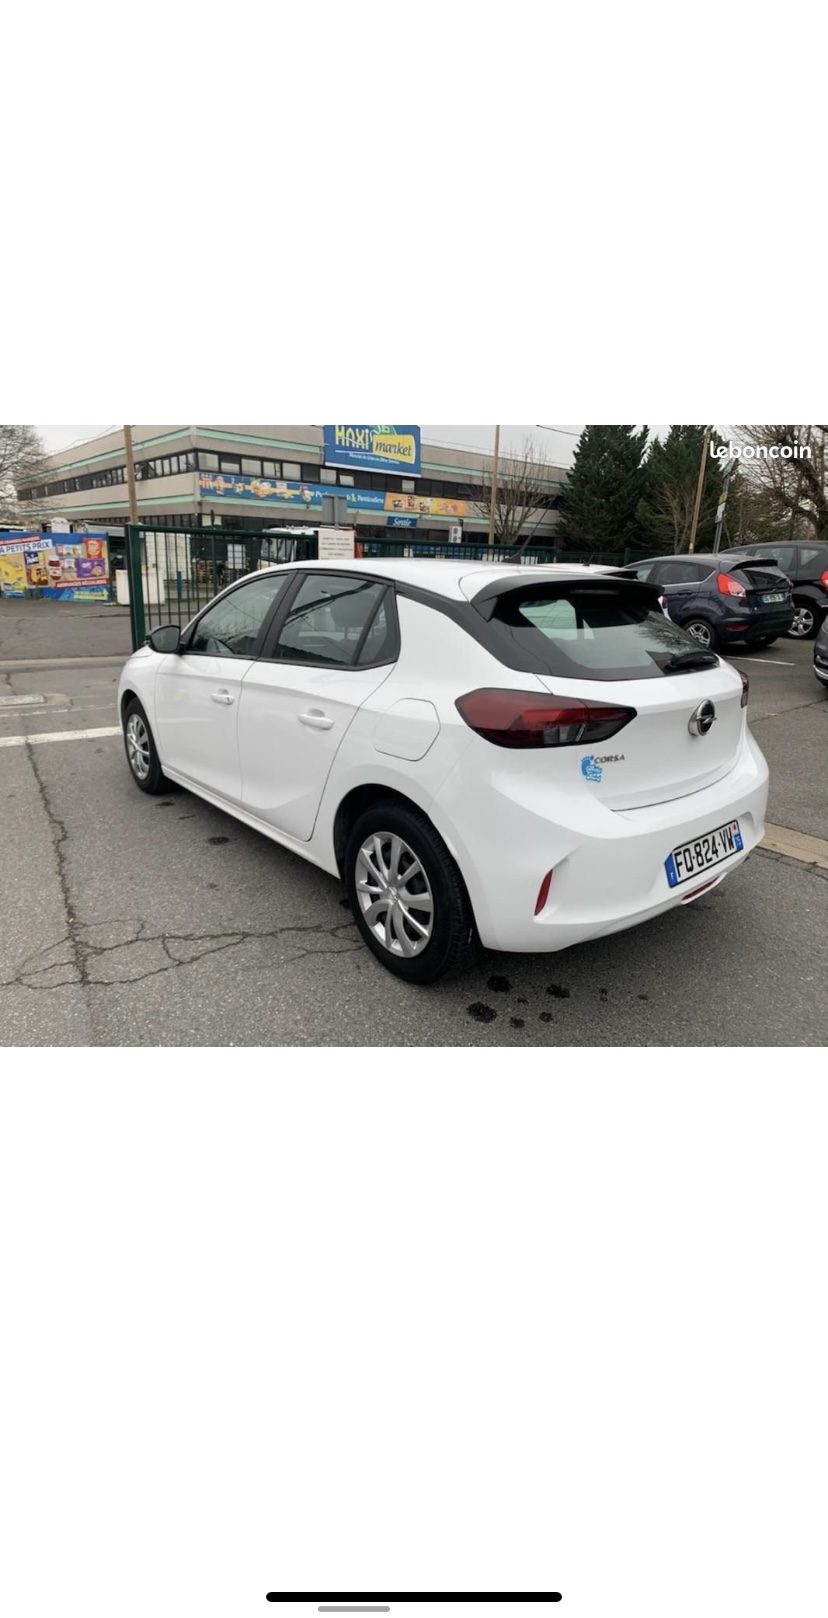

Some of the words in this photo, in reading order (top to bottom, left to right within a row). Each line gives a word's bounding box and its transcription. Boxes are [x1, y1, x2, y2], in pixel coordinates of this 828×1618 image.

[375, 441, 412, 457] market
[6, 544, 31, 552] PETITS
[32, 541, 50, 550] PRIX
[594, 754, 625, 764] CORSA
